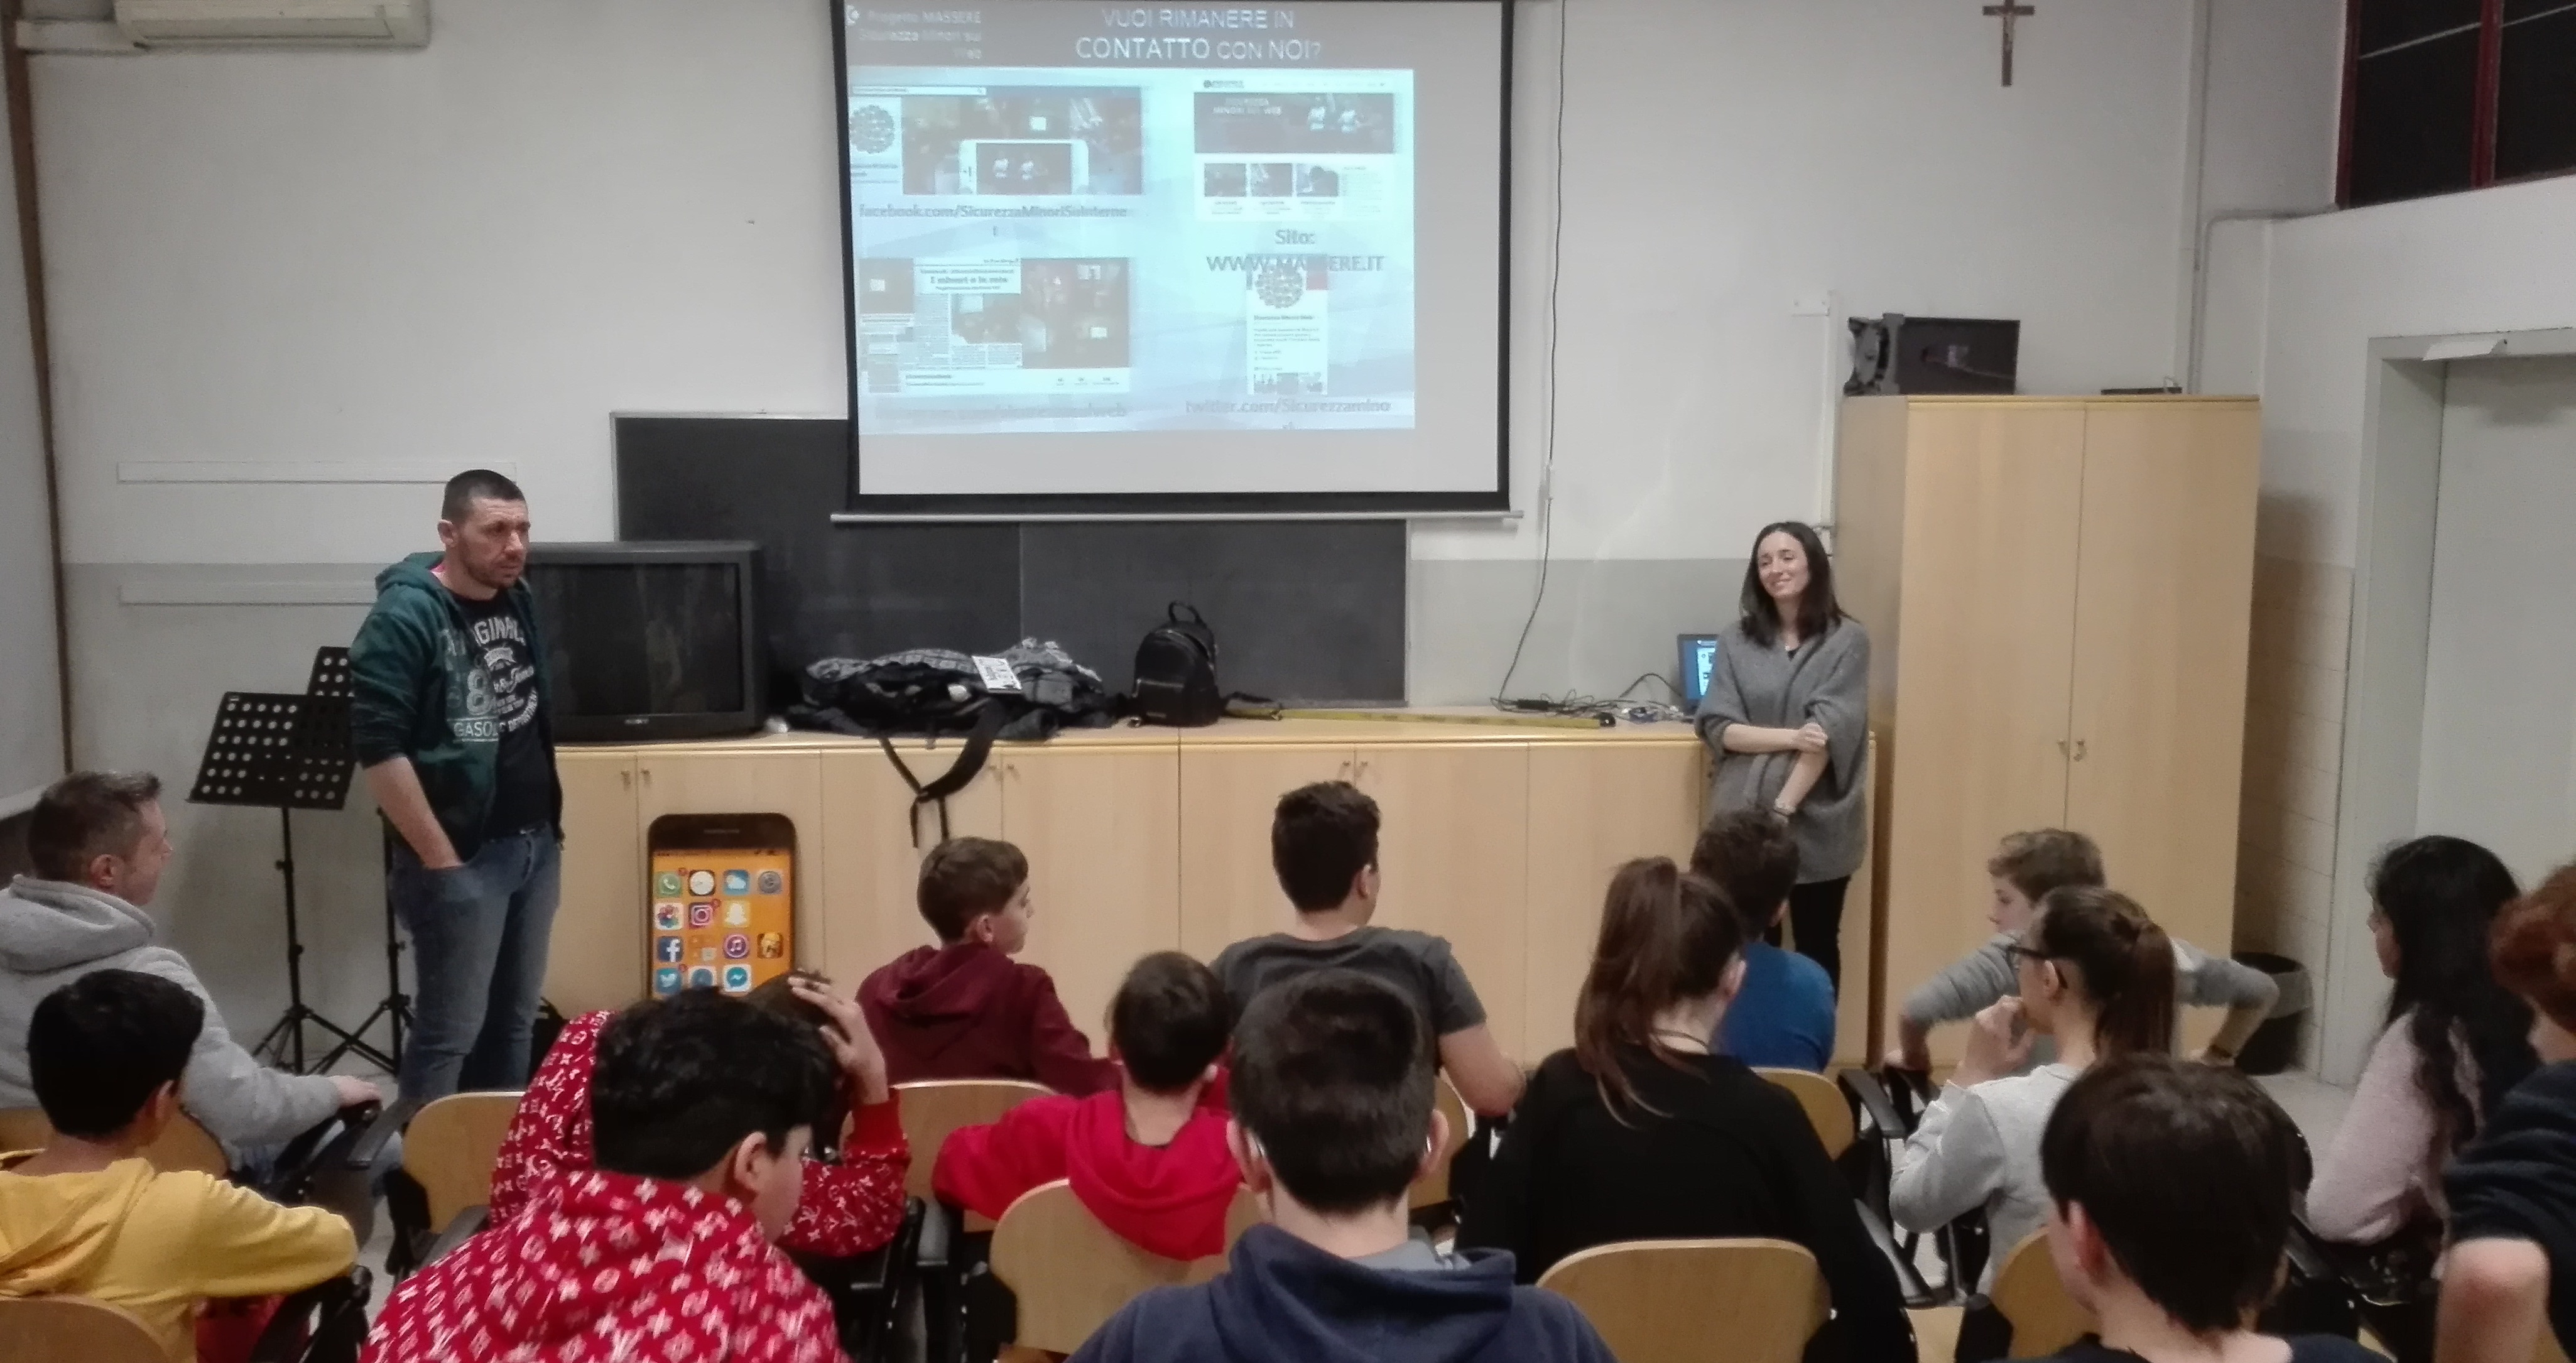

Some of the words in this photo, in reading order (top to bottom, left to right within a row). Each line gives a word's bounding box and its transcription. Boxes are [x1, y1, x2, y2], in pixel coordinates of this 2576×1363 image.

[1102, 9, 1151, 28] VUOI
[1159, 9, 1268, 28] RIMANERE
[1274, 10, 1294, 28] IN
[1075, 37, 1210, 59] CONTATTO
[1269, 39, 1320, 60] NOI?
[1275, 229, 1315, 244] Sito:
[1206, 255, 1385, 271] WWW.MAERE.IT
